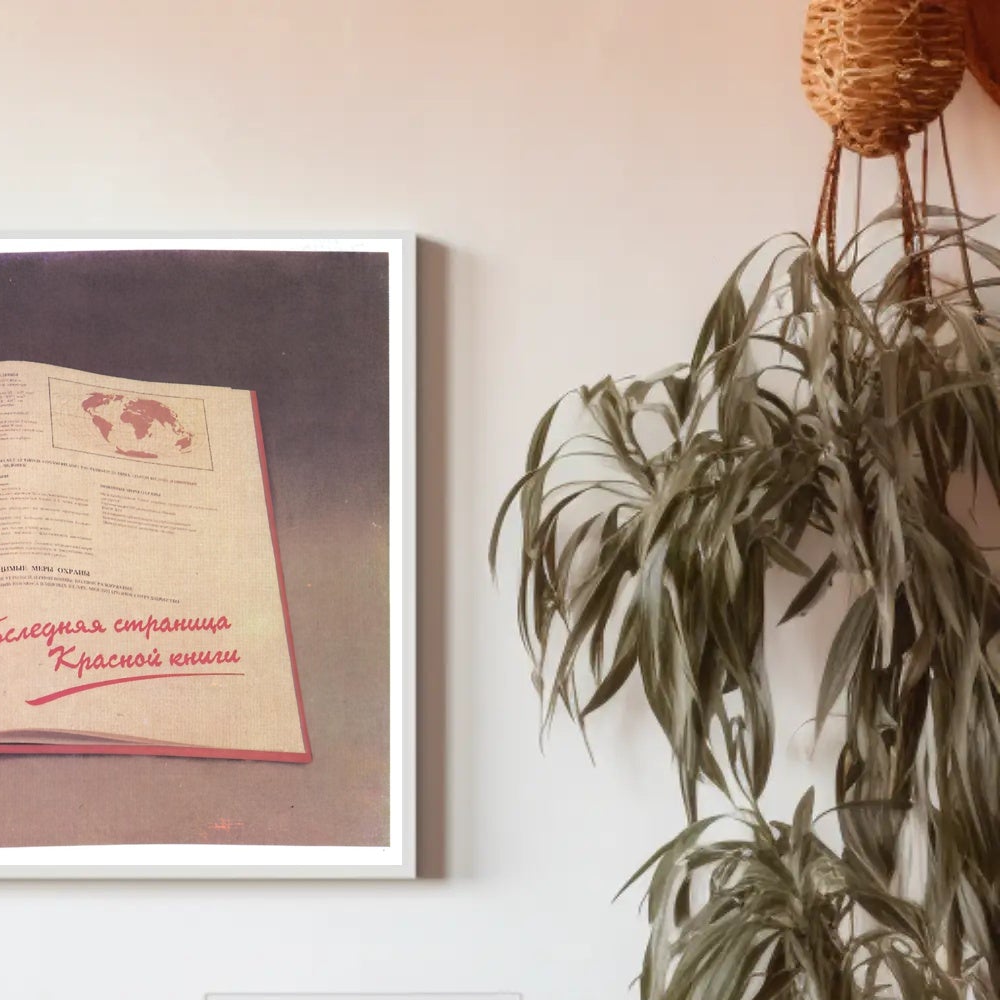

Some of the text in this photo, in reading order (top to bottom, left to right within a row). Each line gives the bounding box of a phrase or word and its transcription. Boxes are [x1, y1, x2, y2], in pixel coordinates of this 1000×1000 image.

[113, 614, 232, 640] страница
[48, 645, 241, 678] Красной книги
